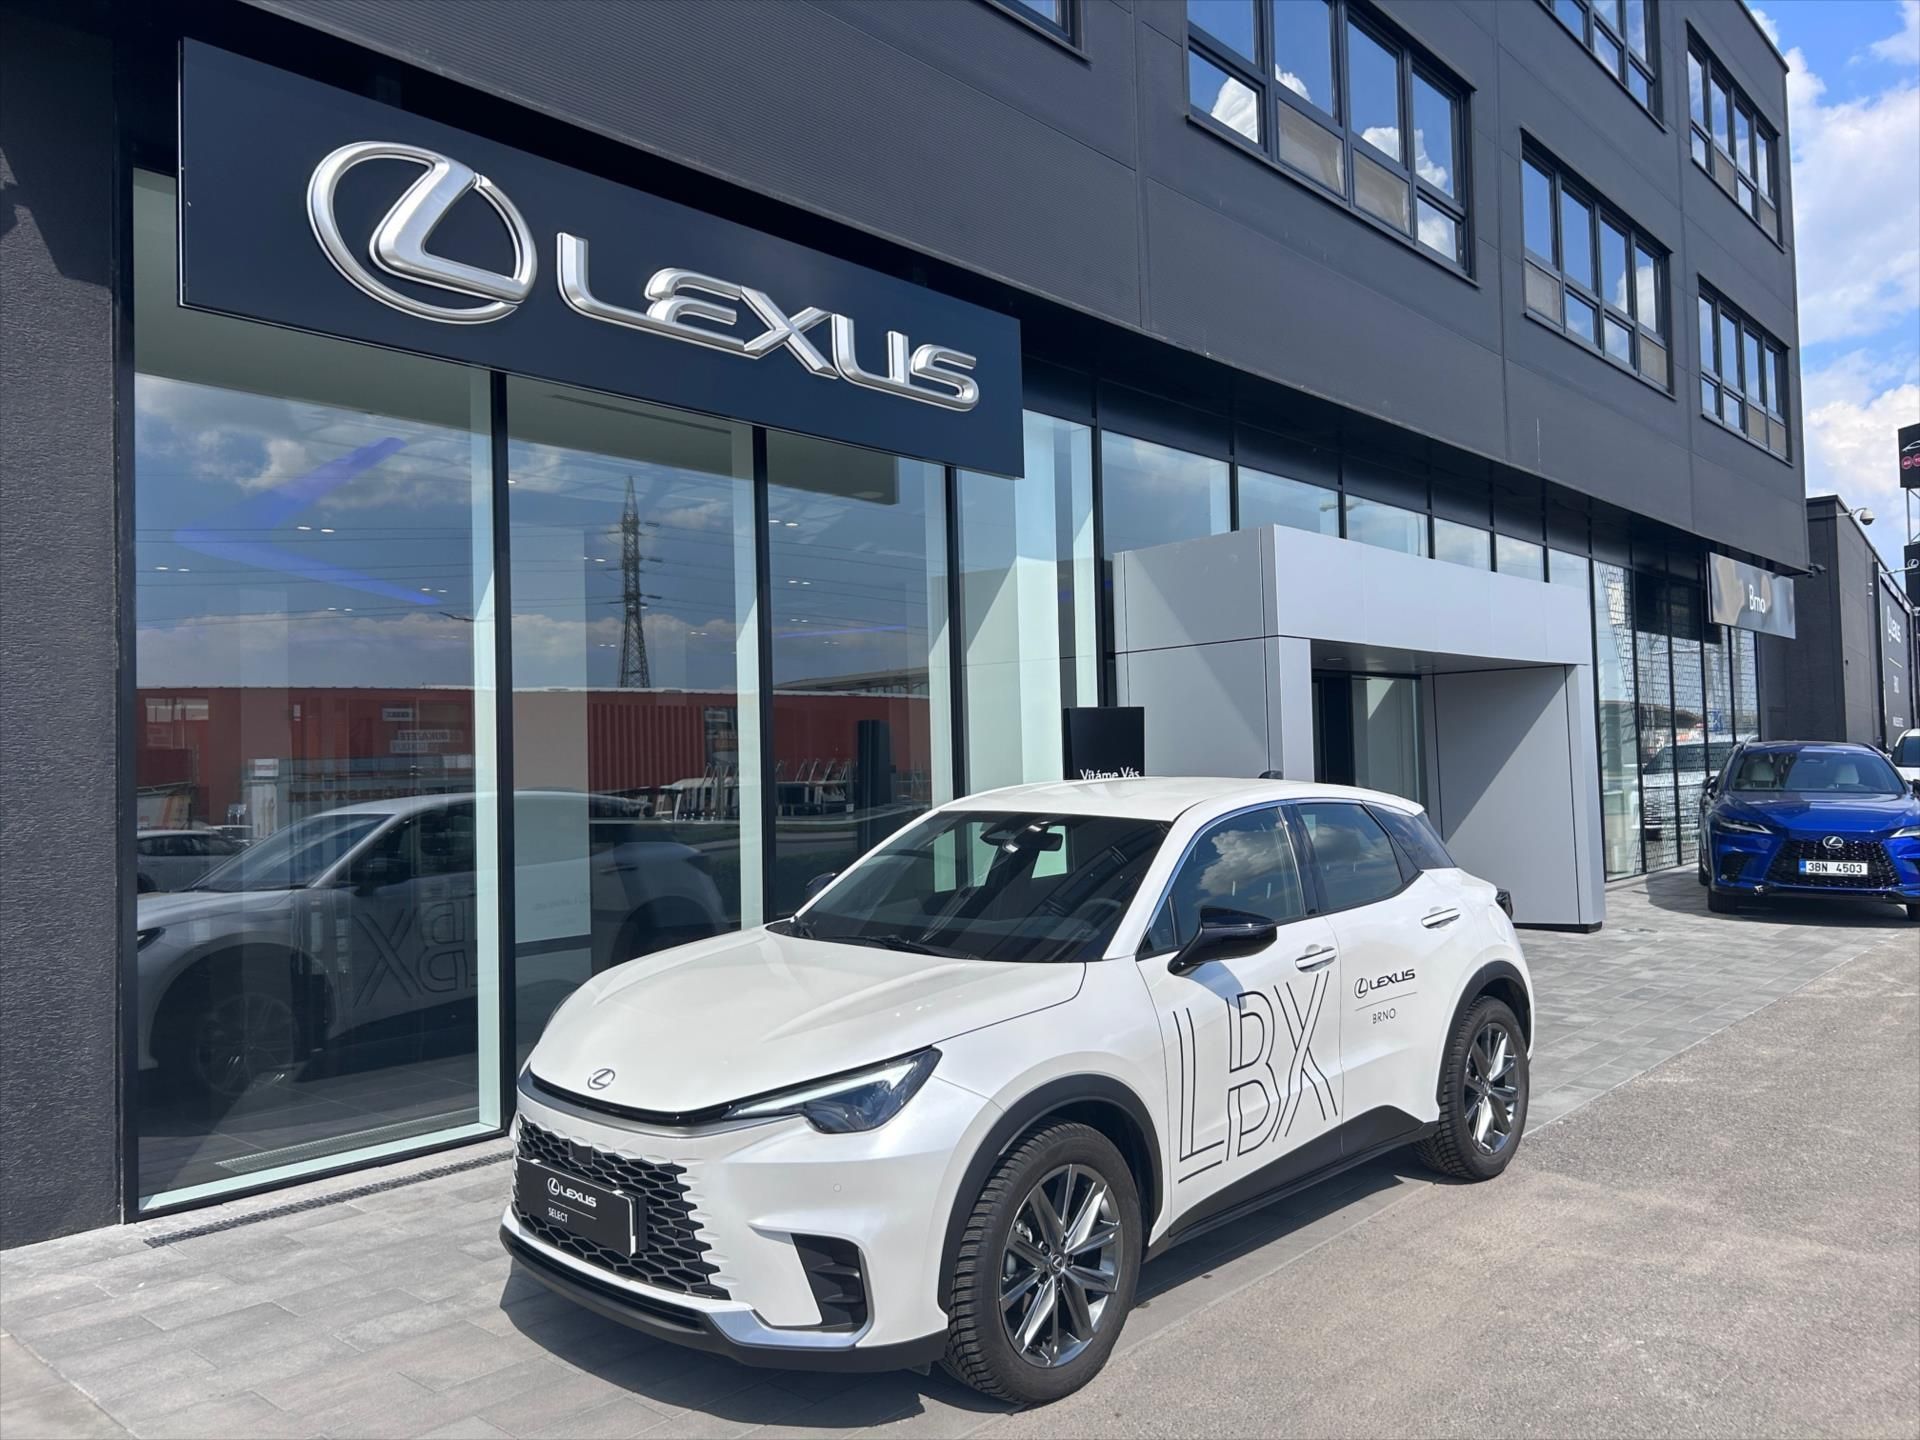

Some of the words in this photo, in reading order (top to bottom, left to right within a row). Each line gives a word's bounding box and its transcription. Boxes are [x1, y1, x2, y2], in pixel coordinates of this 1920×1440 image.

[557, 232, 980, 412] LEXUS
[1749, 584, 1766, 613] Brno
[1120, 766, 1140, 778] Vás
[1836, 863, 1862, 874] 4503
[1369, 968, 1416, 991] LEXUS
[1372, 1008, 1397, 1024] BRNO
[1173, 970, 1338, 1184] LBX
[560, 1185, 597, 1208] LEXUS
[548, 1207, 568, 1224] SELECT
